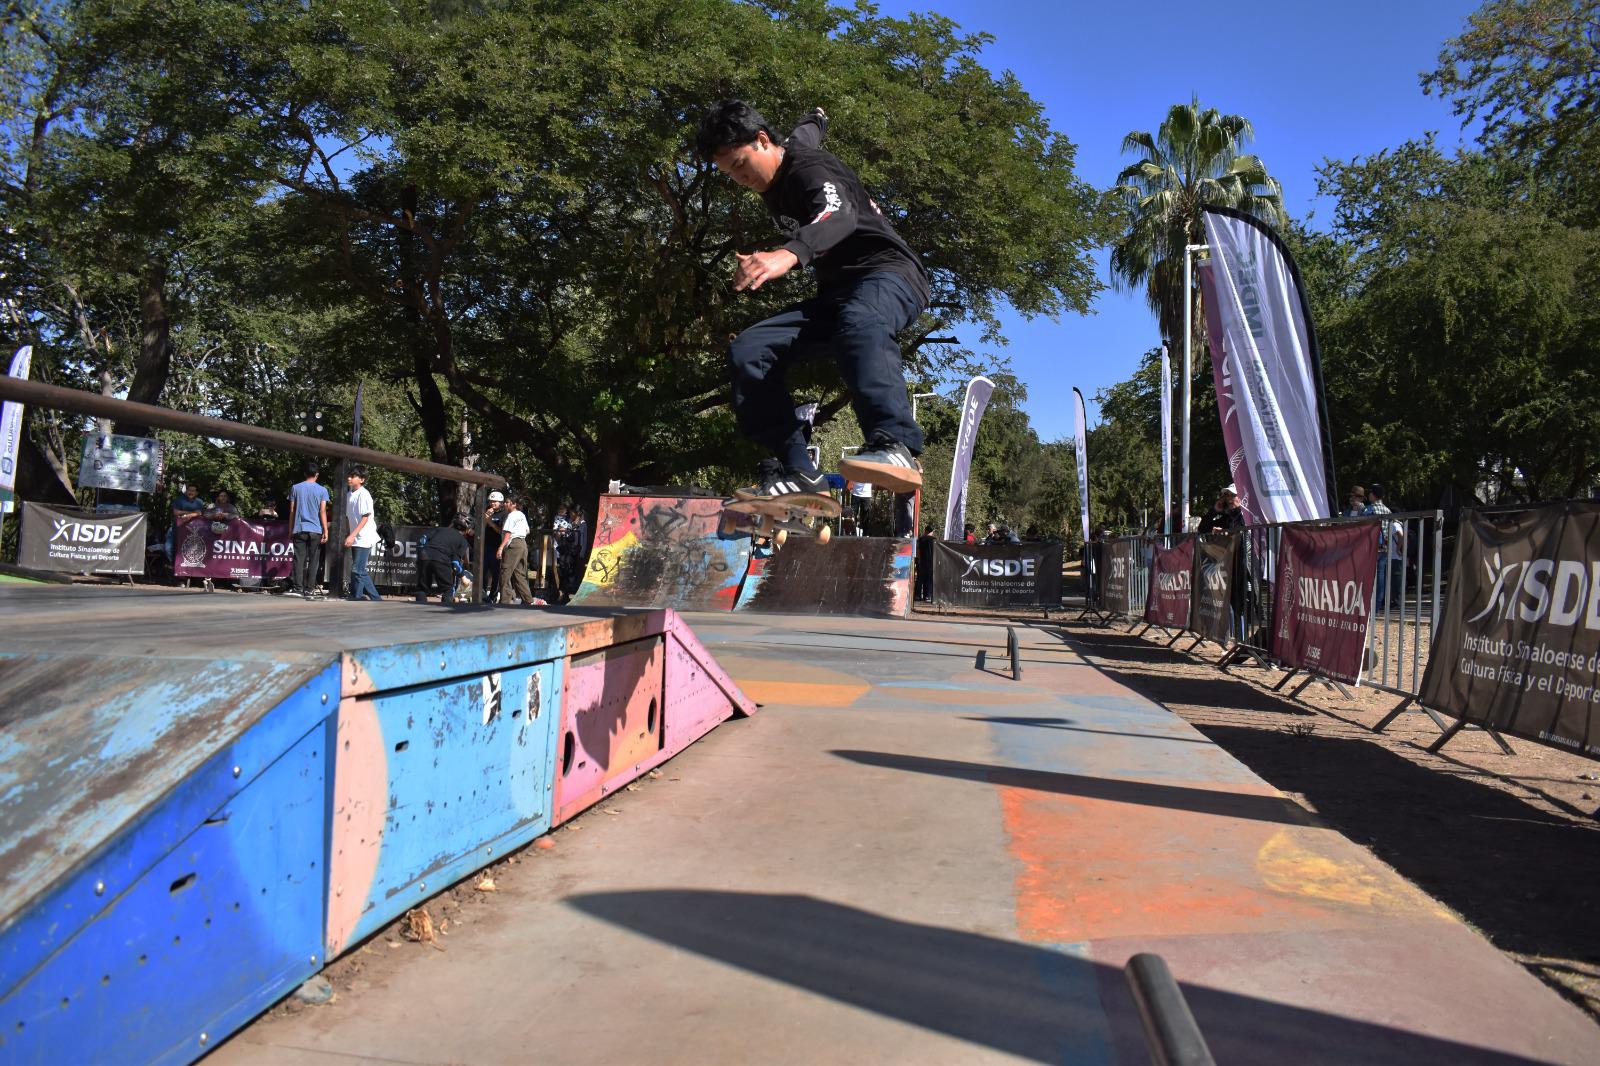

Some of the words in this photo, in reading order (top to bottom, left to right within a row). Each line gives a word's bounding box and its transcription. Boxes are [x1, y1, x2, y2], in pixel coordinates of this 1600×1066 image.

[72, 522, 122, 544] ISDE
[50, 544, 76, 552] Instituto
[78, 546, 112, 554] Sinaloense
[213, 540, 294, 556] SINALOA
[982, 558, 1034, 576] ISDE
[1298, 576, 1366, 616] SINALOA
[1464, 632, 1513, 657] Instituto
[1516, 640, 1584, 673] Sinaloense
[1461, 658, 1494, 680] Cultura
[1525, 674, 1536, 692] y
[1538, 674, 1552, 692] el
[1556, 677, 1600, 703] Deporte
